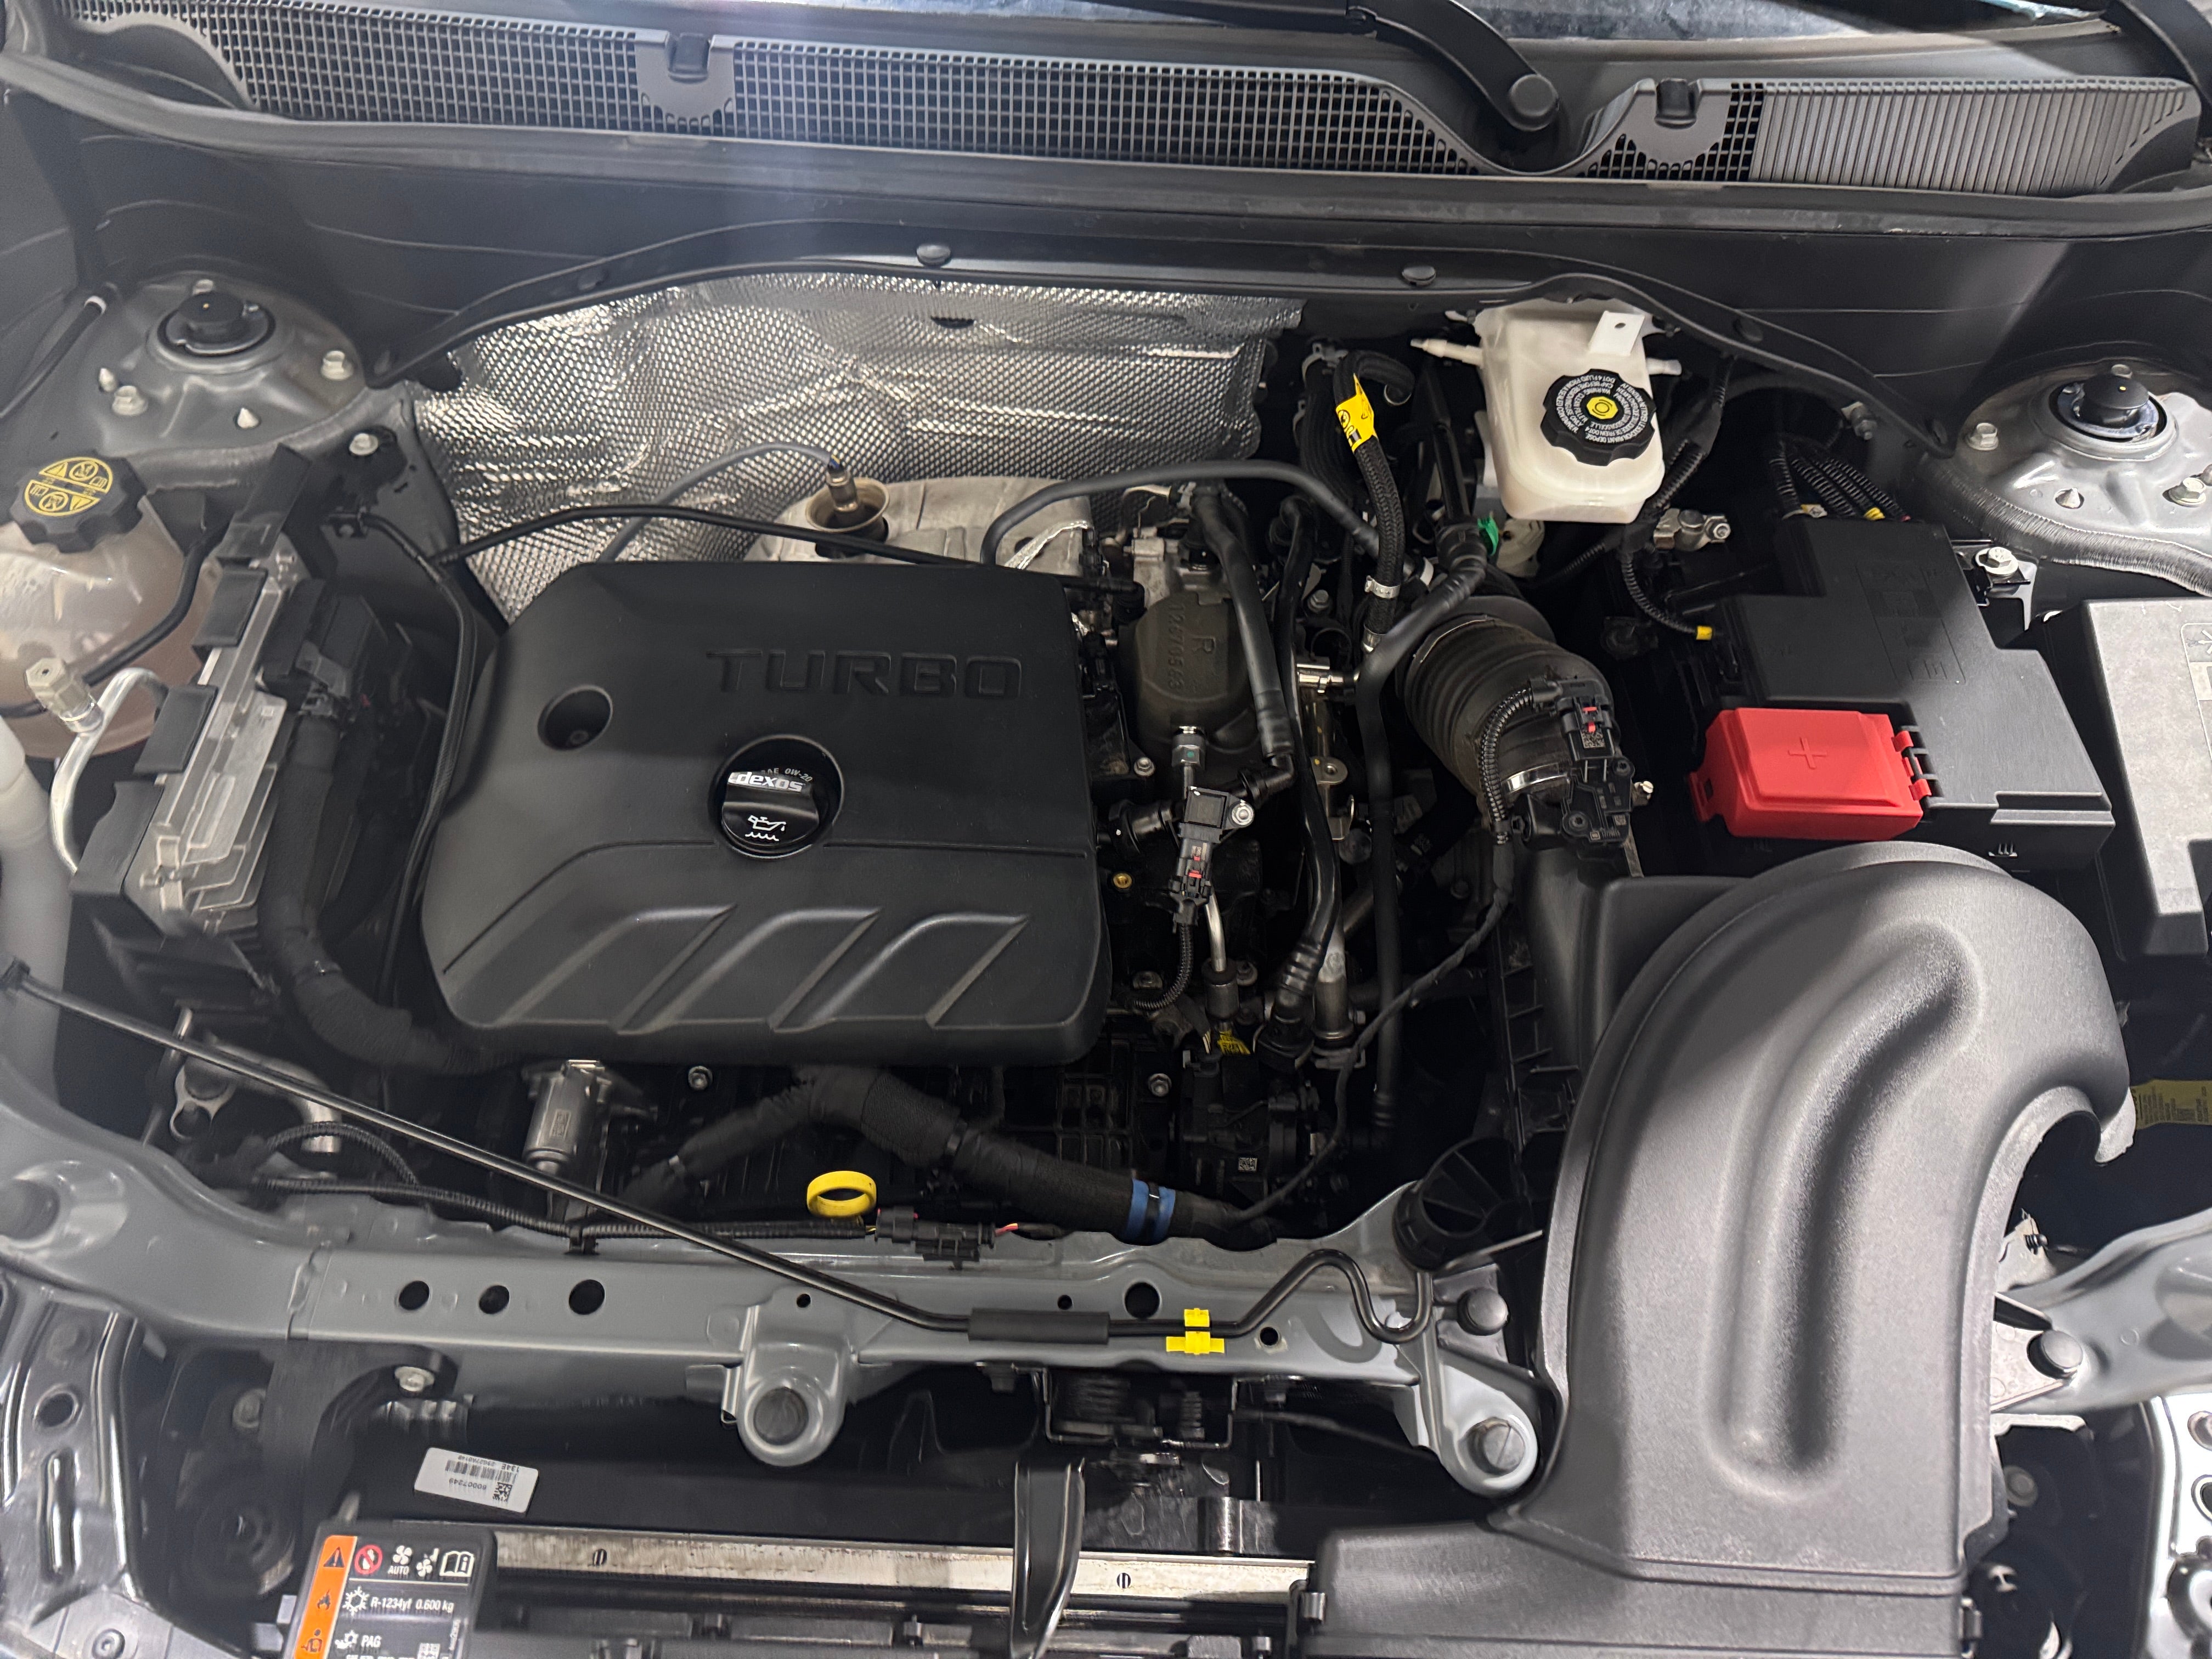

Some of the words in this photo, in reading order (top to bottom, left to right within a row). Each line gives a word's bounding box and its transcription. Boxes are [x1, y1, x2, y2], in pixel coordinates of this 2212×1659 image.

[1569, 415, 1583, 427] ONLY
[707, 648, 1022, 698] TURBO
[736, 772, 803, 792] dexos
[785, 768, 813, 782] 0W-20
[387, 1566, 410, 1575] AUTO
[371, 1597, 413, 1612] R-1234yf
[415, 1599, 441, 1611] 0.600
[442, 1600, 455, 1613] kg
[361, 1635, 382, 1647] PAG
